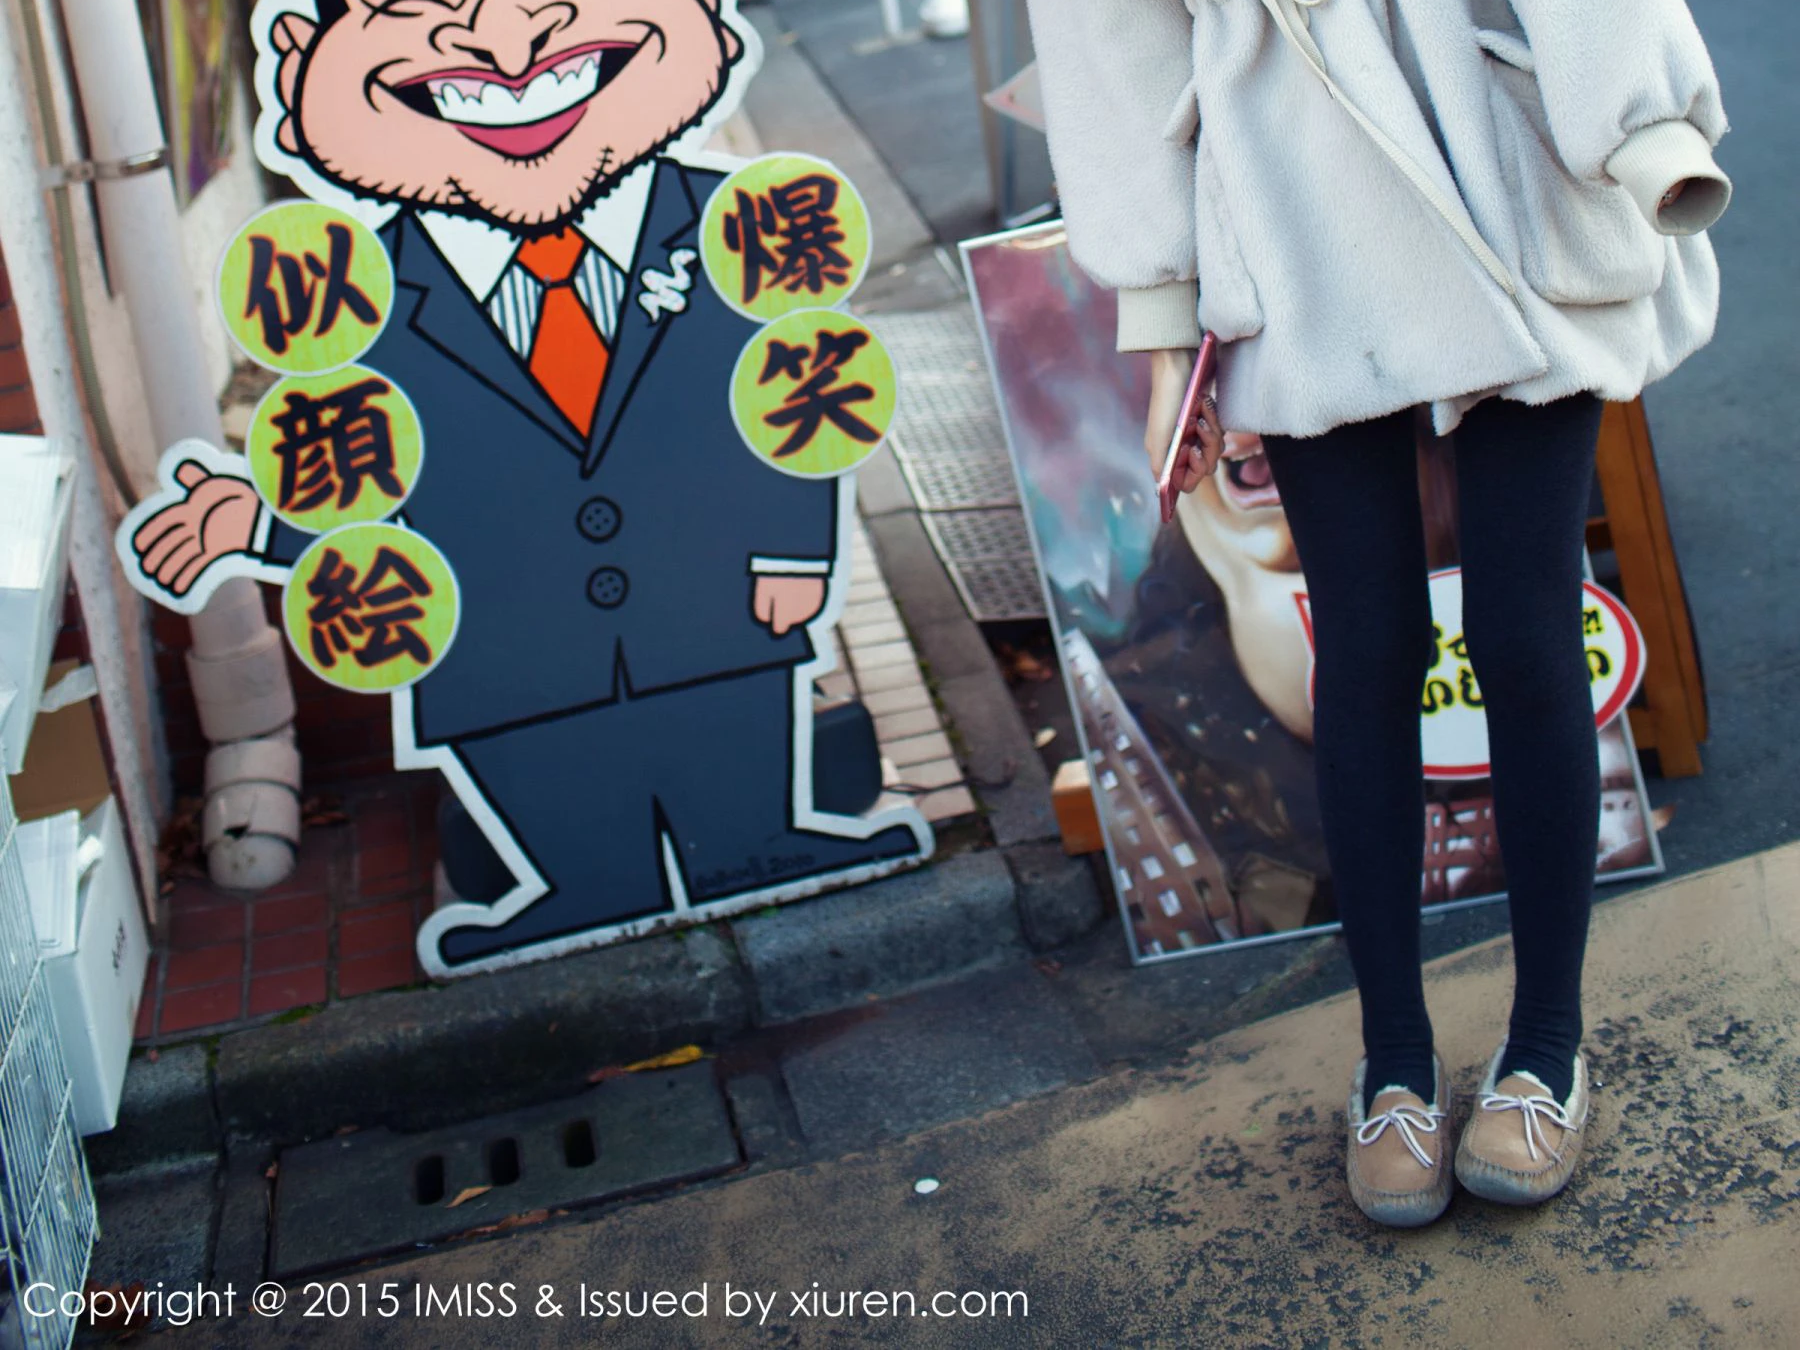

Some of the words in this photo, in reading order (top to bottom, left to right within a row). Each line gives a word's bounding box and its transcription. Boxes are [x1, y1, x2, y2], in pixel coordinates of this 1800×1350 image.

[244, 222, 433, 668] 似顔絵
[723, 173, 882, 459] 爆笑
